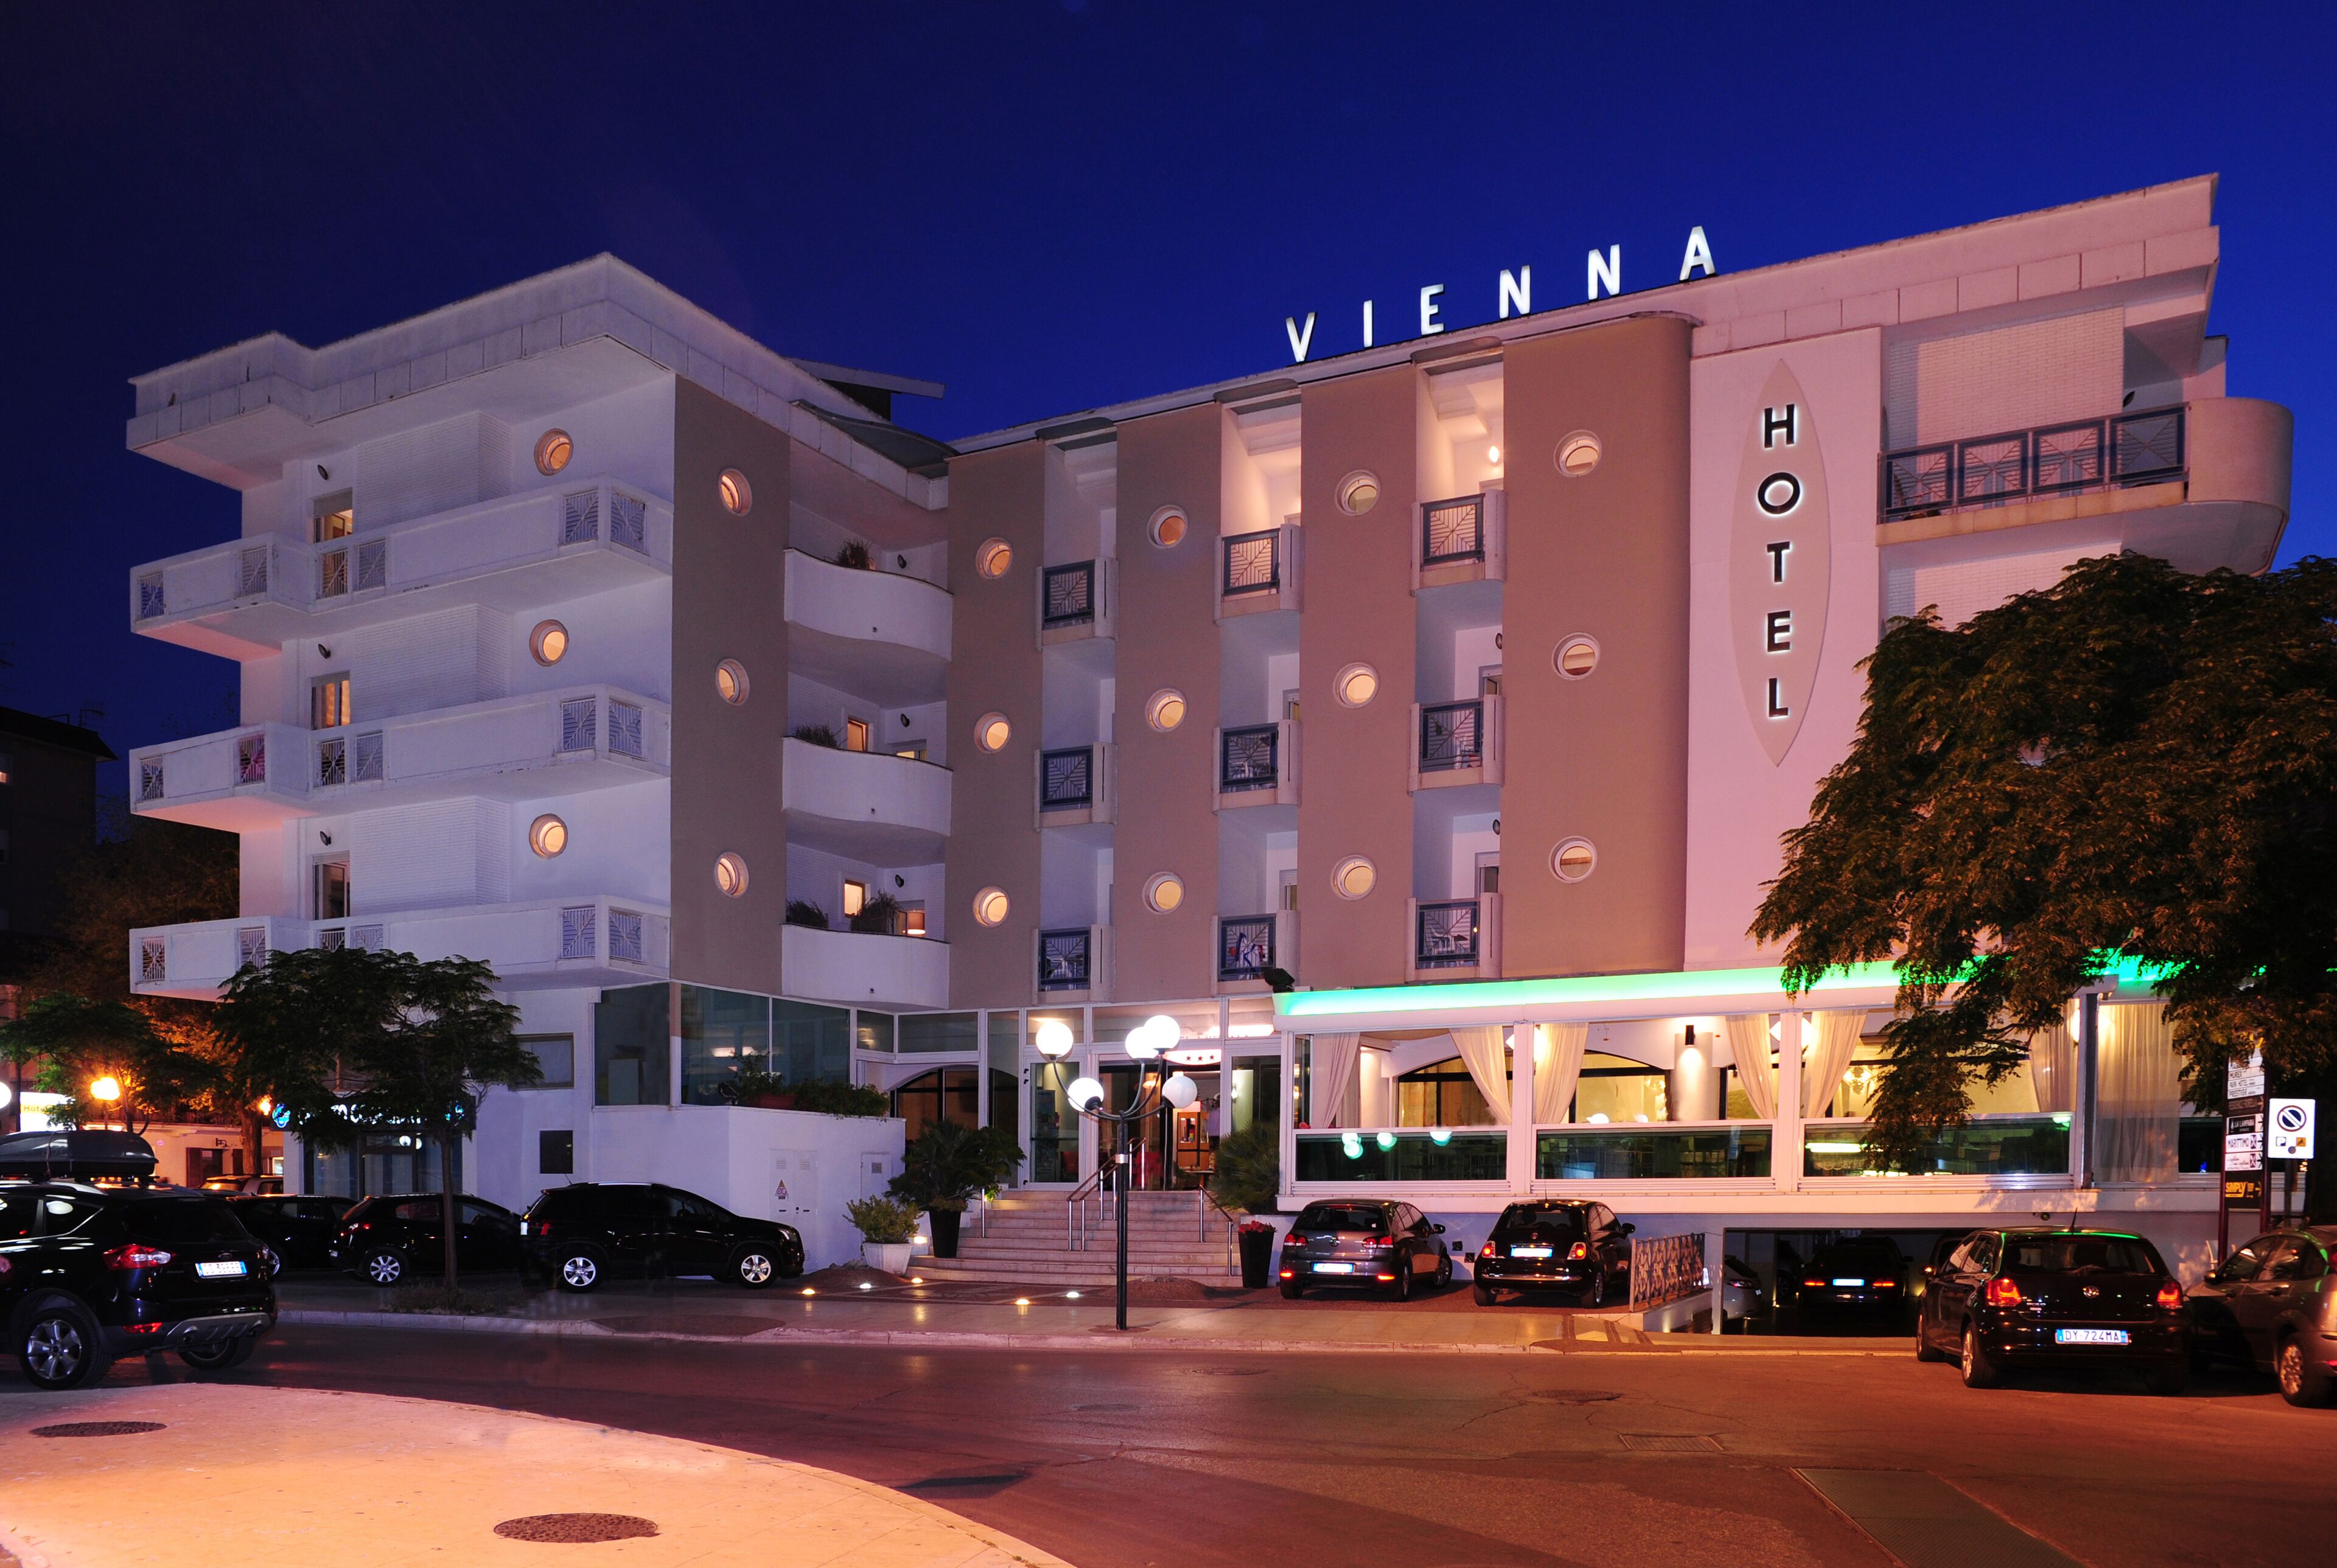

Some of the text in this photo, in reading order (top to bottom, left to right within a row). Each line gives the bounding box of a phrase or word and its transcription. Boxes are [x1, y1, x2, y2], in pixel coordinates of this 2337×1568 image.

[1285, 226, 1716, 363] VIENNA
[1757, 403, 1801, 717] HOTEL
[2226, 1182, 2246, 1193] SIMPLY
